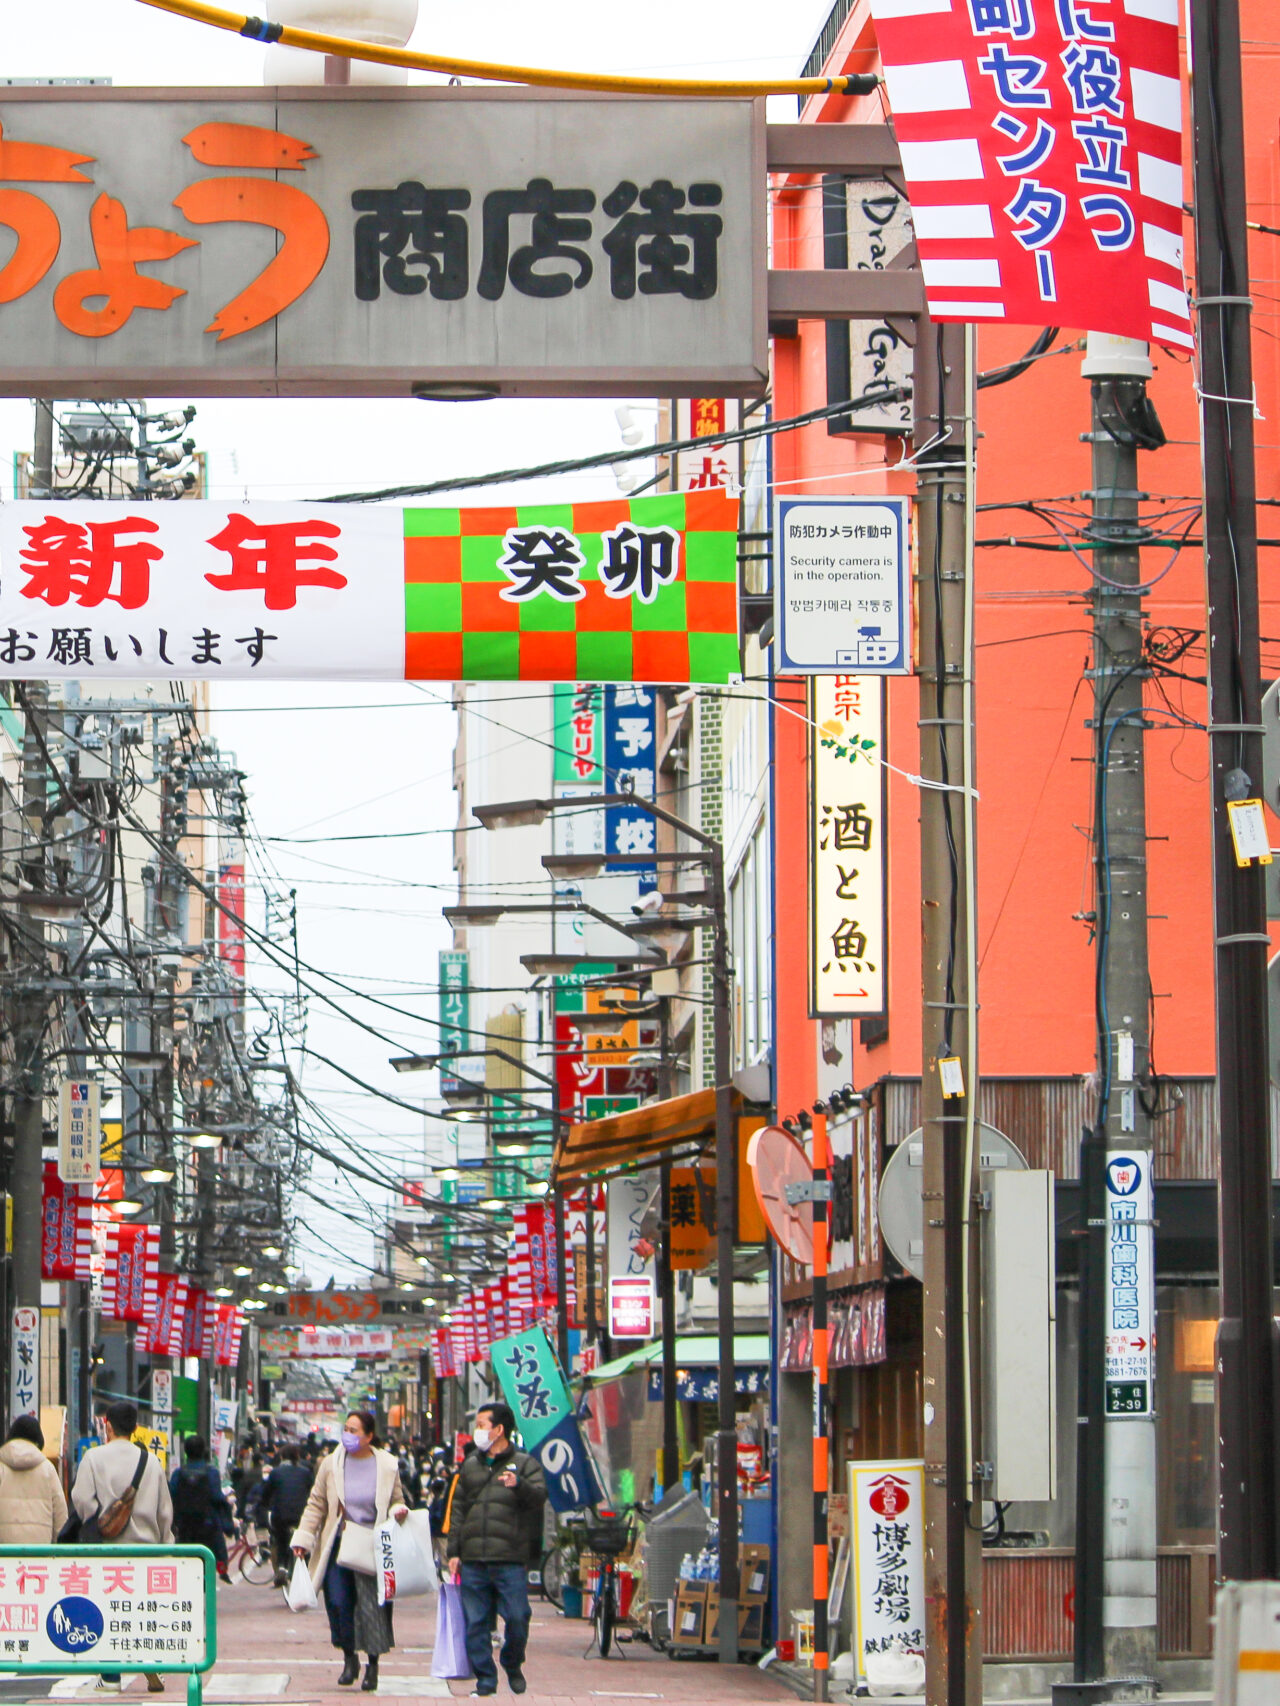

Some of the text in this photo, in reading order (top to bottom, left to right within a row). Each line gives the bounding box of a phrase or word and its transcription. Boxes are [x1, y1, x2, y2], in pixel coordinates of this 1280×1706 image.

[864, 327, 898, 415] Gat
[789, 525, 893, 539] 防犯カメラ作動中
[506, 527, 677, 598] 癸卯
[790, 555, 893, 569] Security camera is
[793, 570, 884, 583] in the operation.
[820, 803, 877, 973] 酒と魚
[1110, 1200, 1139, 1329] 市川歯科医院
[505, 1344, 558, 1419] お茶
[1111, 1387, 1142, 1398] 千住
[1112, 1400, 1142, 1410] 2-39
[872, 1522, 912, 1624] 博多劇場
[109, 1601, 131, 1613] 平日
[109, 1637, 188, 1651] 千住本町商店街
